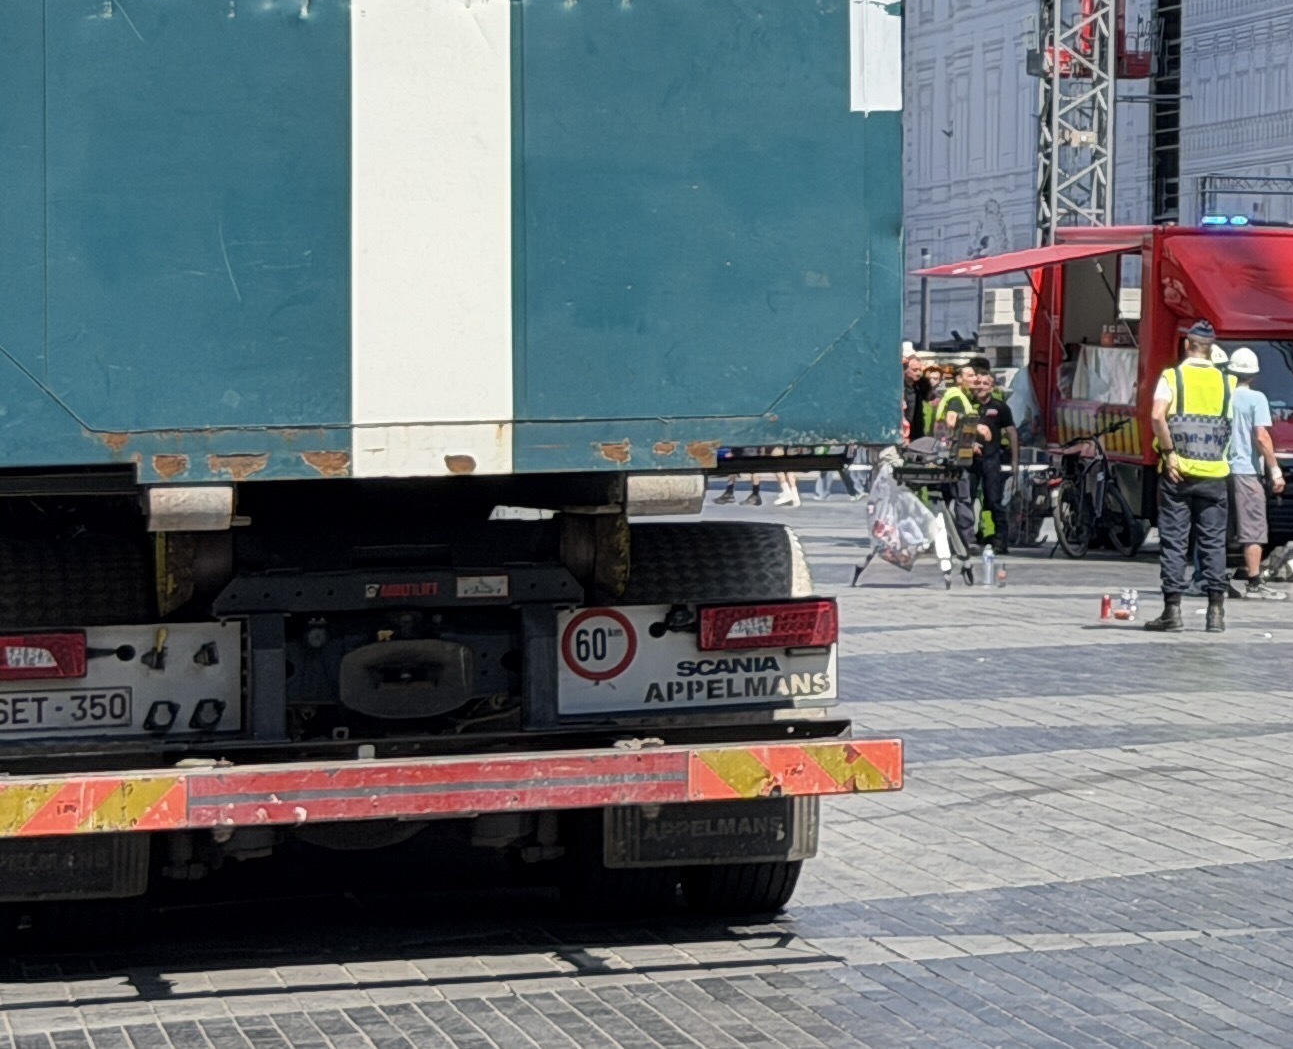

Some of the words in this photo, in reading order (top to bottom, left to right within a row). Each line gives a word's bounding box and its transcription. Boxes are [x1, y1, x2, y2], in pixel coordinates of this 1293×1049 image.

[575, 627, 608, 662] 60
[608, 628, 624, 639] km
[676, 656, 781, 677] SCANIA
[643, 671, 832, 704] APPELMANS
[643, 814, 785, 841] APPELMANS
